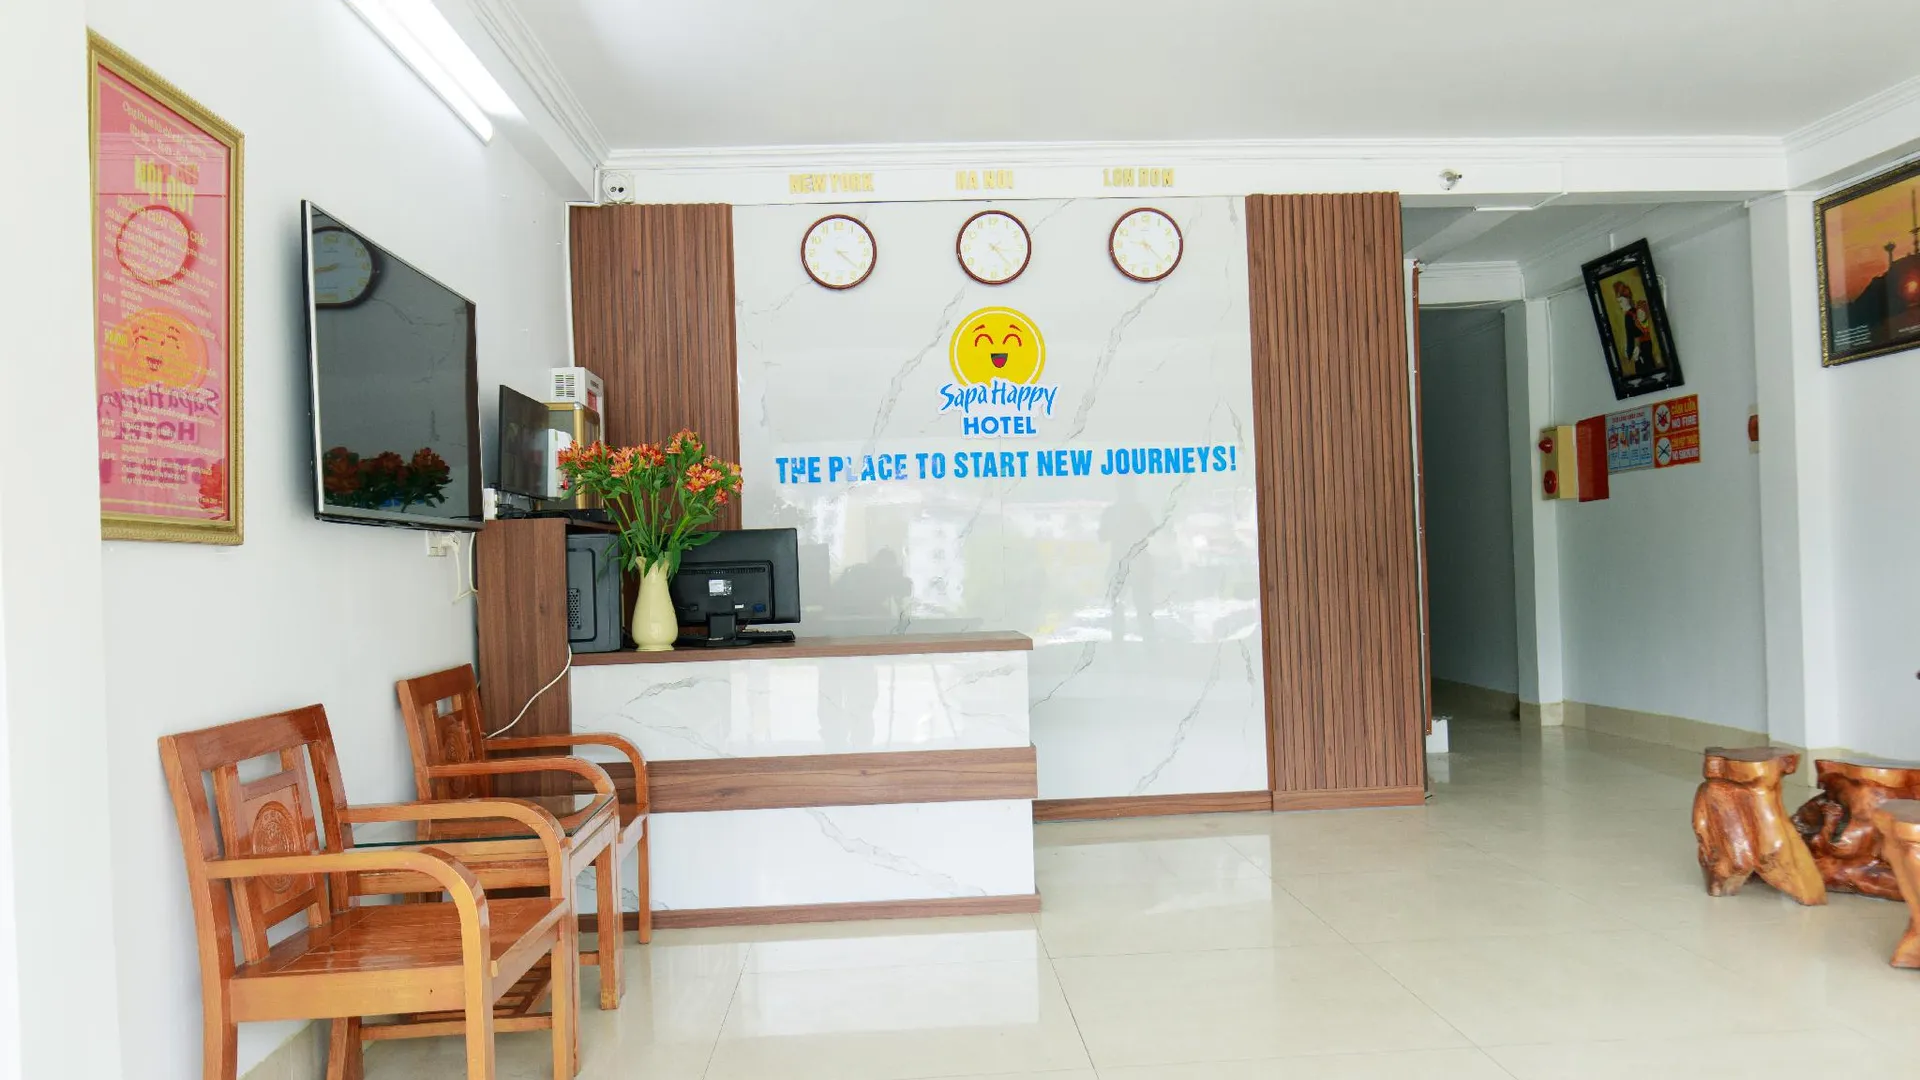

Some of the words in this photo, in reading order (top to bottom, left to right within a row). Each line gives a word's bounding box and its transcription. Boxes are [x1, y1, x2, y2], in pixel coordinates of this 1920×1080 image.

[788, 173, 827, 194] NEW
[830, 172, 875, 193] YORK
[956, 169, 979, 190] HA
[983, 169, 1014, 190] NOI
[940, 383, 988, 413] Sapa
[991, 380, 1058, 415] Happy
[963, 416, 1037, 435] HOTEL
[775, 456, 822, 484] THE
[828, 453, 908, 484] PLACE
[915, 452, 946, 480] TO
[953, 451, 1030, 480] START
[1037, 449, 1093, 478] NEW
[1100, 445, 1237, 476] JOURNEYS!
